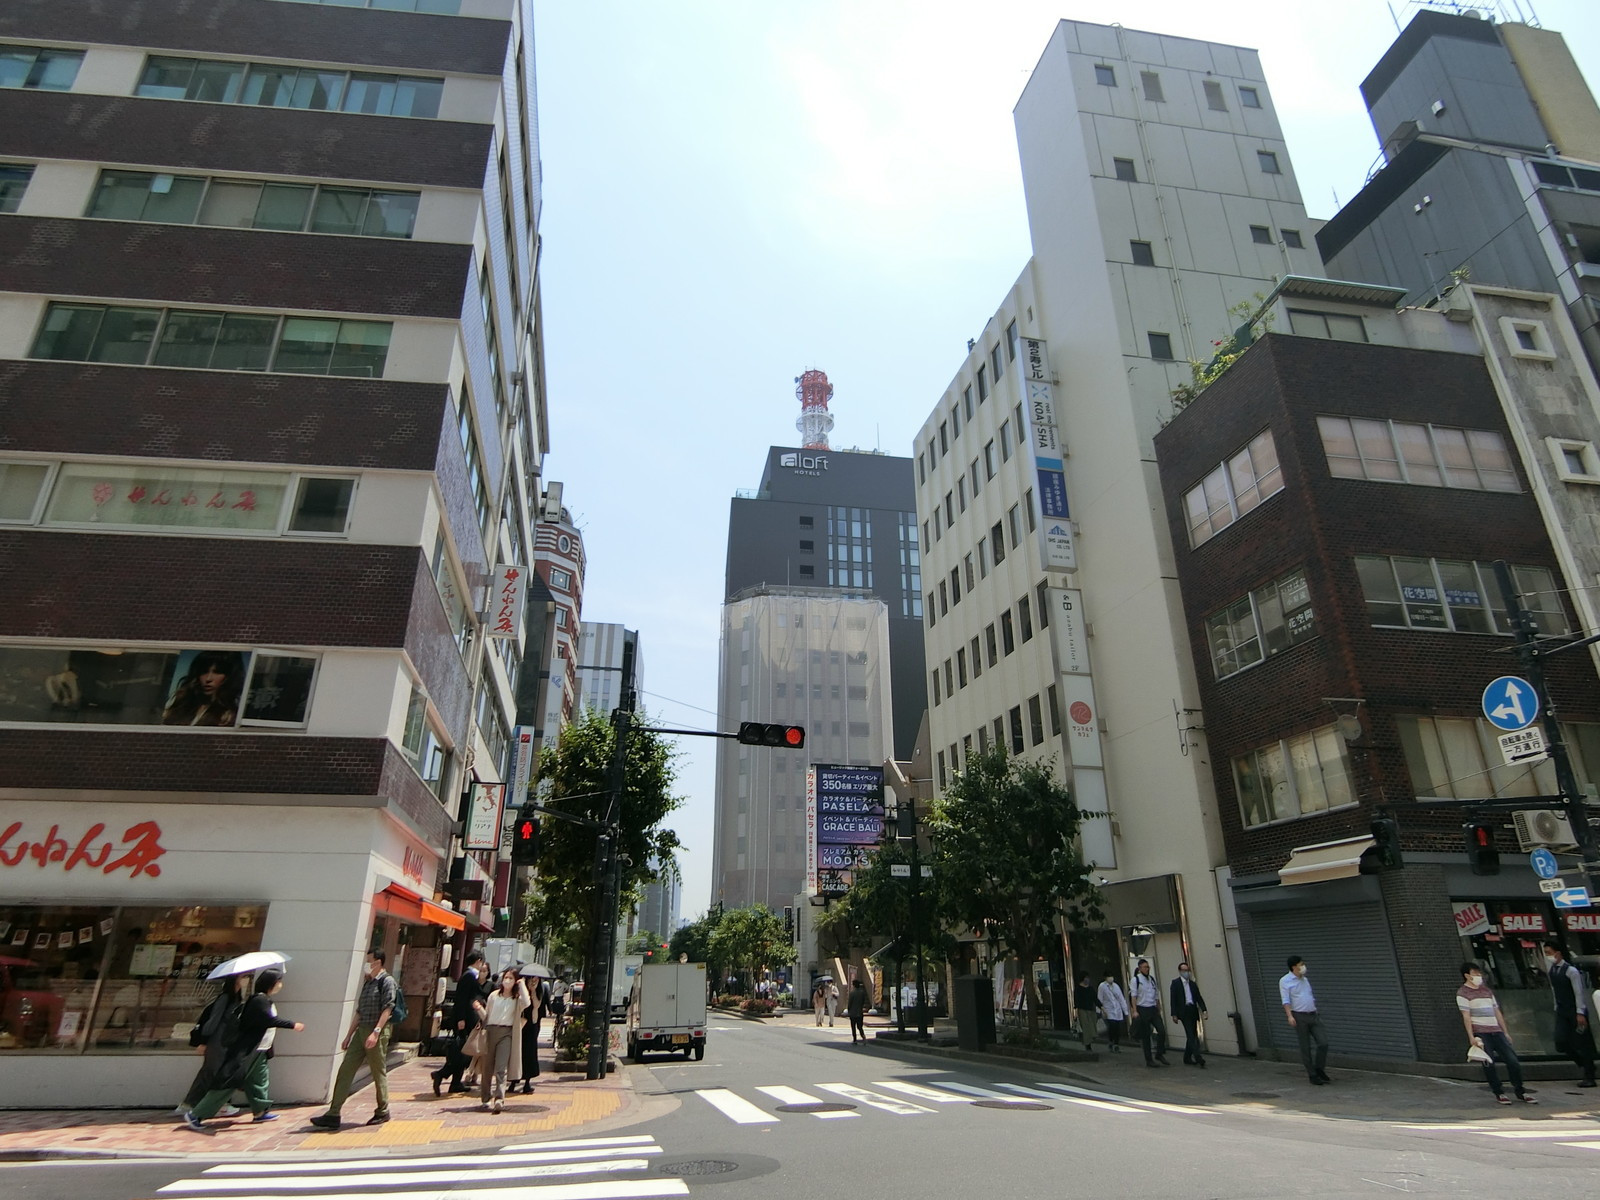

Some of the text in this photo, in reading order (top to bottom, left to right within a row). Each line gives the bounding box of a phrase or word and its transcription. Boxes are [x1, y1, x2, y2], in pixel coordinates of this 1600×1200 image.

[781, 453, 828, 470] aloft
[1403, 587, 1438, 600] 花空間
[494, 569, 519, 633] せんねん灸
[1501, 732, 1538, 746] 自転車を除く
[1505, 741, 1540, 753] 一方通行
[823, 802, 869, 812] PASELA
[823, 822, 880, 832] GRACE BALI
[823, 856, 868, 866] MODIS
[1535, 857, 1546, 876] P
[822, 883, 849, 891] CASCADE
[1454, 903, 1485, 929] SALE
[1502, 915, 1543, 930] SALE
